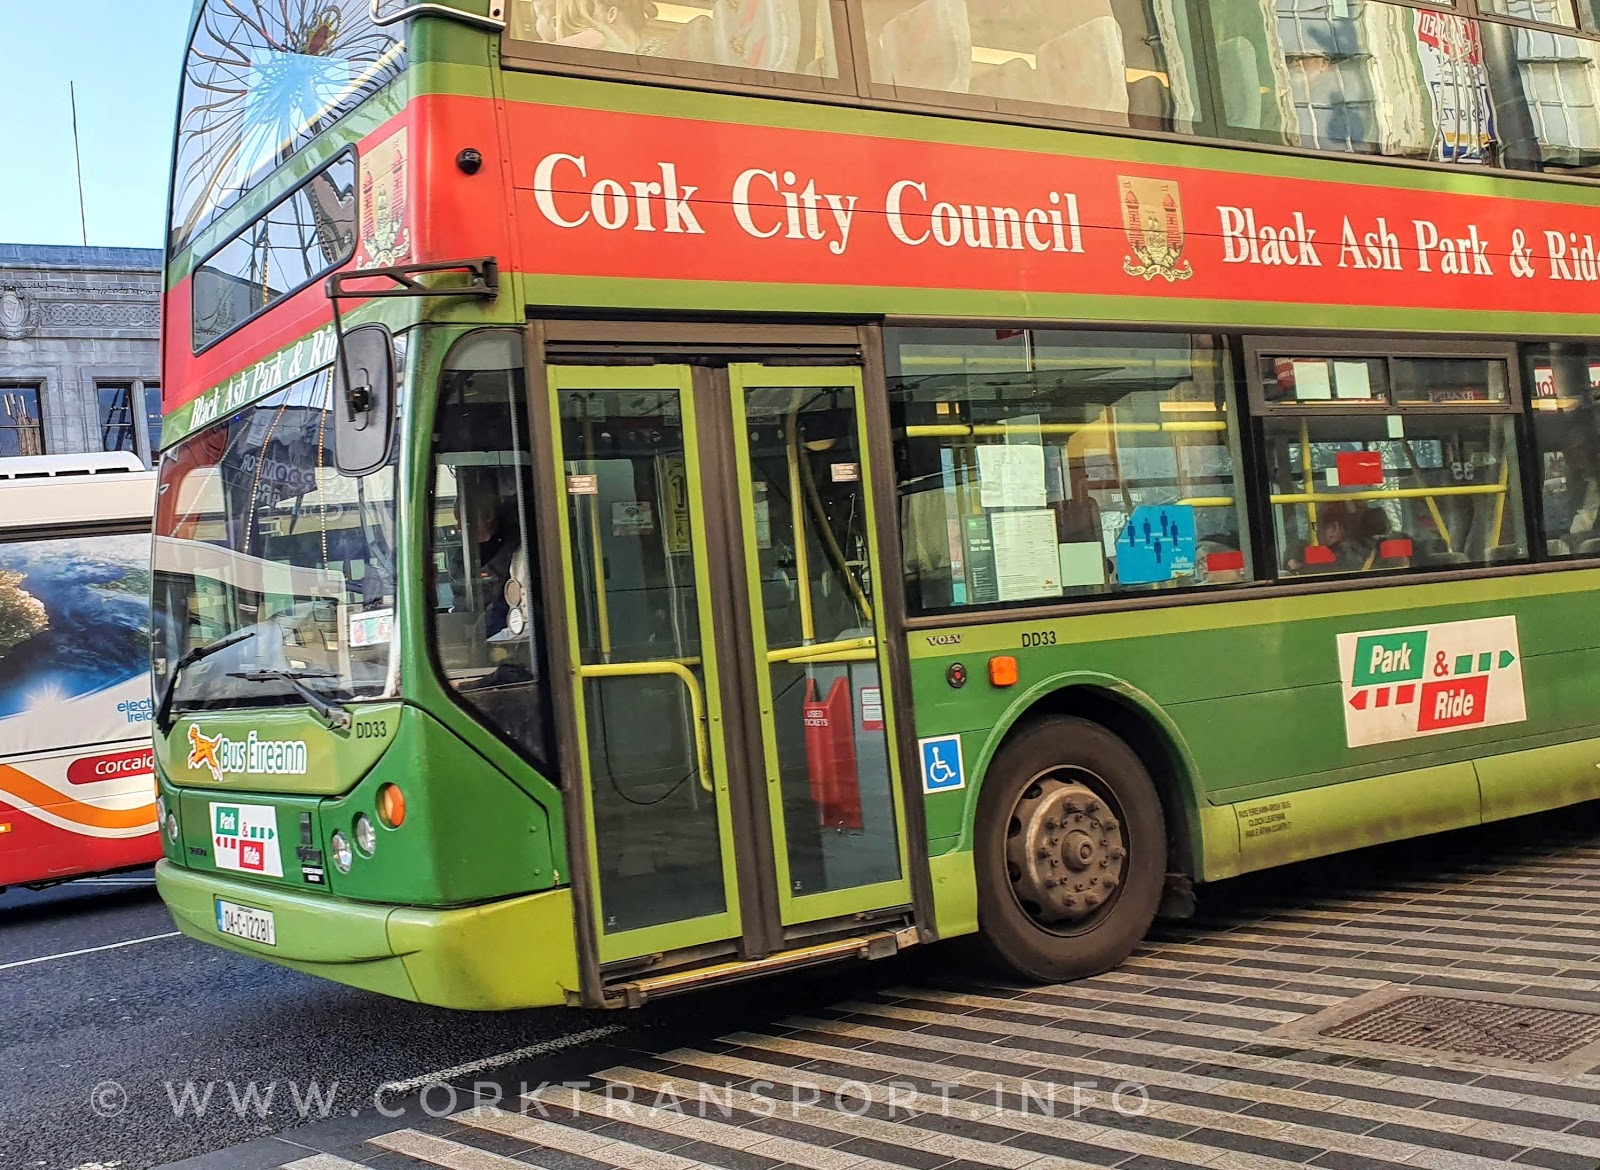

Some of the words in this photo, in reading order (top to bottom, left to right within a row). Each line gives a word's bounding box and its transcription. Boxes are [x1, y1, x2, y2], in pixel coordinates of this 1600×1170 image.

[533, 152, 706, 234] Cork
[732, 168, 858, 255] City
[885, 180, 1085, 253] Council
[1216, 205, 1322, 266] Black
[1337, 214, 1403, 270] Ash
[1412, 219, 1494, 276] Park
[1509, 228, 1536, 279] &
[188, 387, 221, 431] Black
[222, 371, 248, 413] Ash
[249, 351, 285, 399] Park
[288, 340, 304, 379] &
[1021, 631, 1057, 648] DD33
[1369, 642, 1412, 675] Park
[1433, 650, 1449, 677] &
[806, 710, 824, 718] USED
[1433, 688, 1475, 720] Ride
[356, 721, 387, 739] DD33
[221, 738, 247, 773] Bus
[248, 730, 307, 774] Éireann
